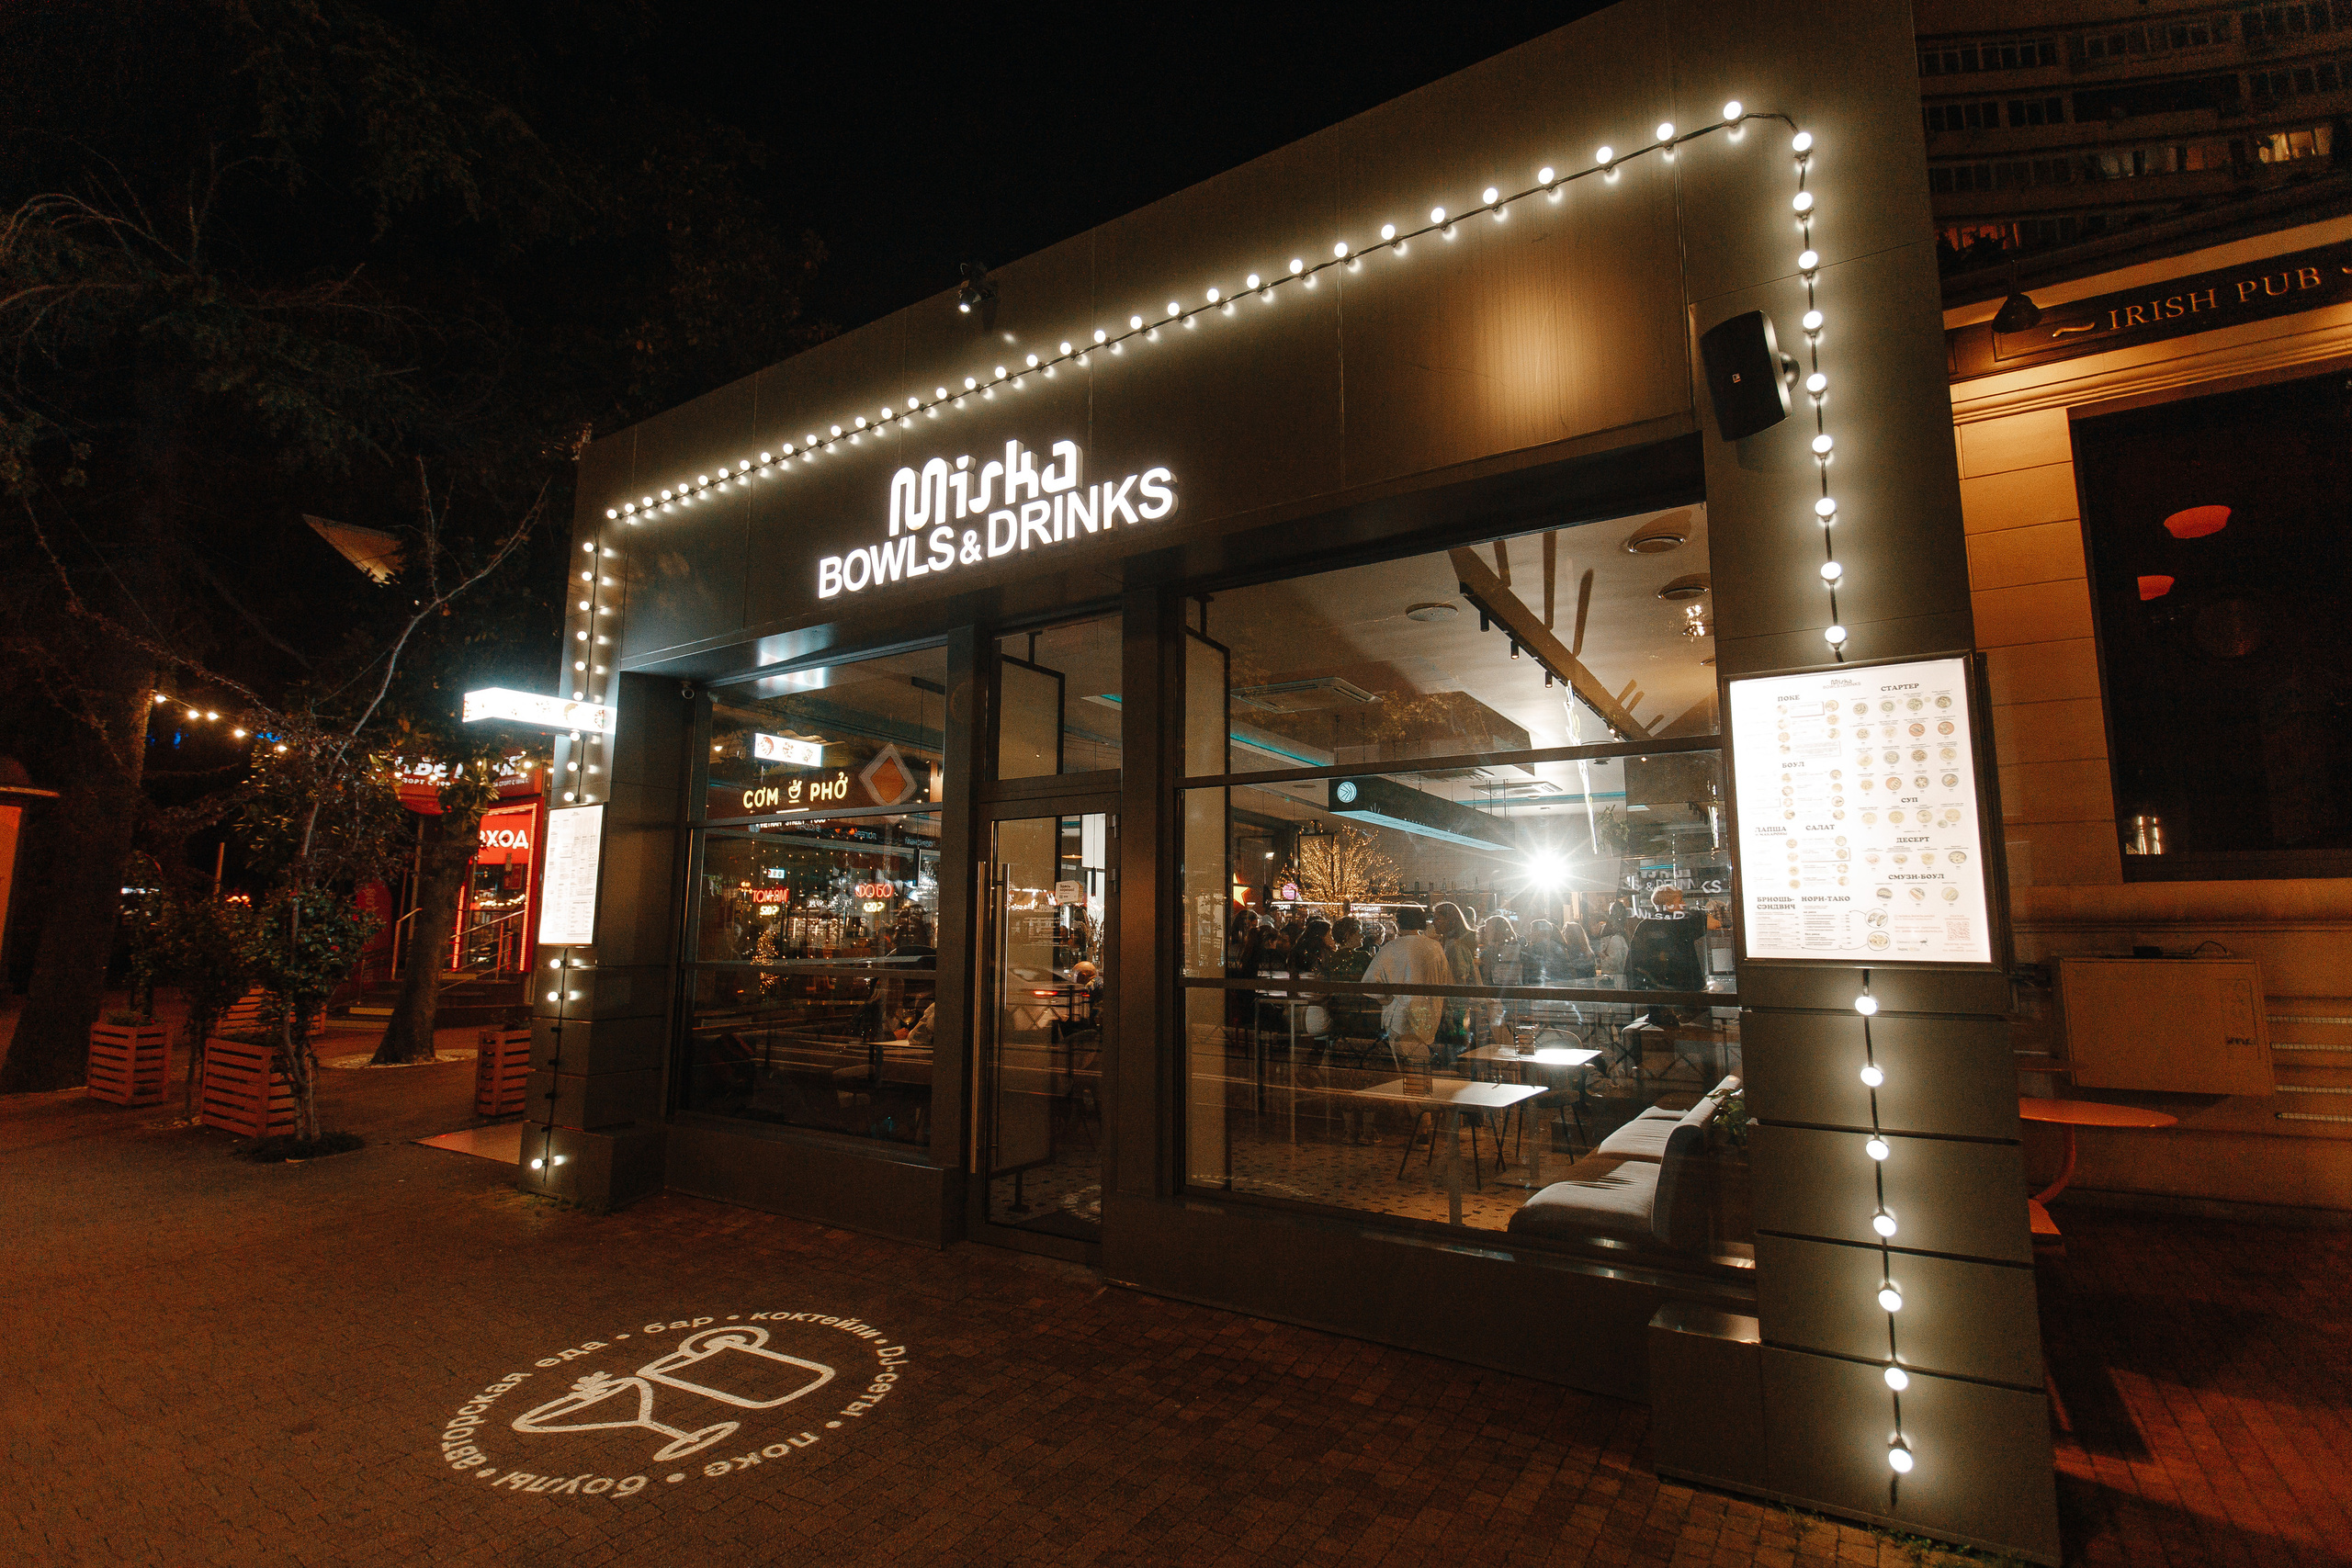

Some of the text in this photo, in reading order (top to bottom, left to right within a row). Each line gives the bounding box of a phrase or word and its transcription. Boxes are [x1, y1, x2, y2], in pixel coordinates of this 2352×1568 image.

[2108, 267, 2322, 330] IRISH PUB
[1881, 683, 1919, 692] СТАРТЕР
[643, 1315, 714, 1335] бар
[750, 1312, 883, 1339] коктейли
[535, 1340, 608, 1368] еда
[441, 1372, 533, 1470] авторская
[704, 1431, 820, 1477] поке
[491, 1471, 649, 1498] боулы
